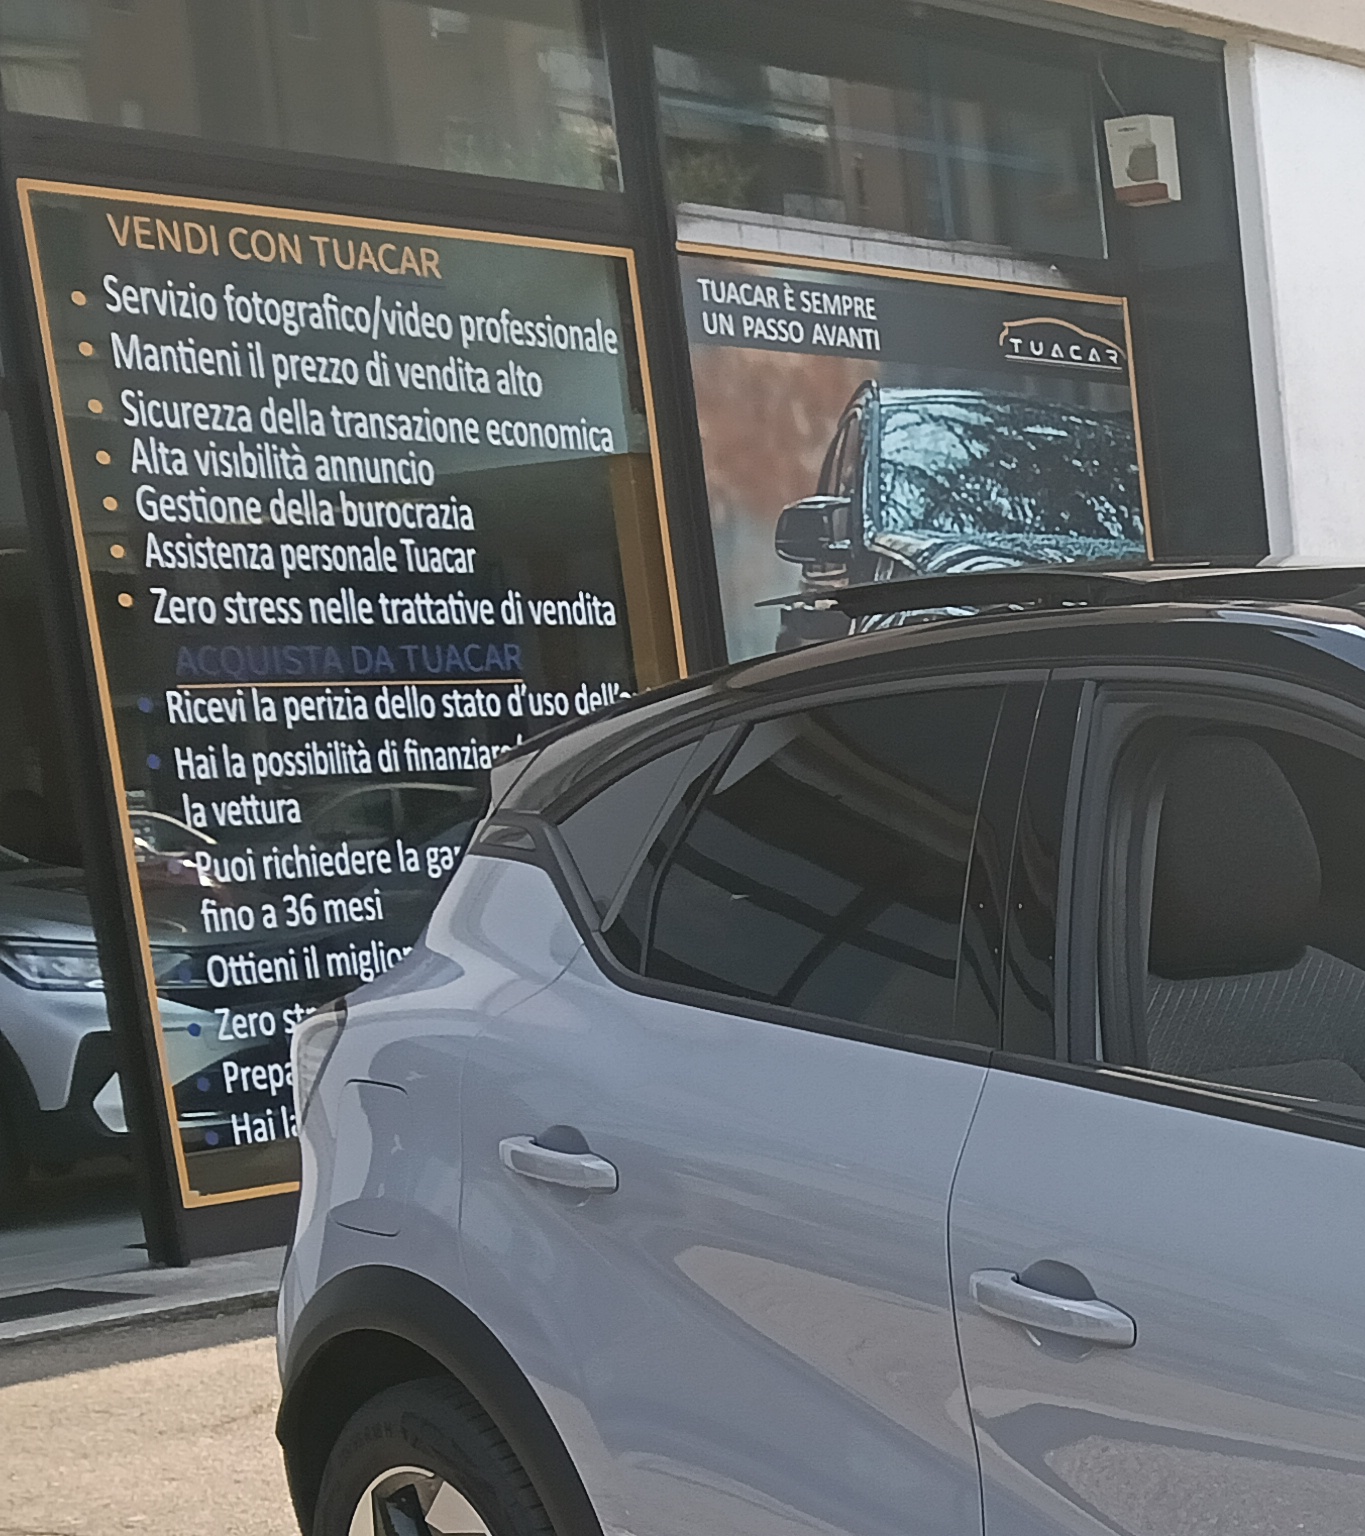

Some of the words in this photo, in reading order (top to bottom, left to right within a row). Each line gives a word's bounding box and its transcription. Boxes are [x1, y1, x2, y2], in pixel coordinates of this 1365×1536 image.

[107, 214, 219, 256] VENDI
[229, 228, 302, 264] CON
[310, 236, 441, 278] TUACAR
[104, 275, 217, 320] Servizio
[224, 284, 452, 340] fotografico/video
[460, 309, 617, 354] professionale
[697, 279, 780, 308] TUACAR
[784, 283, 796, 311] È
[800, 291, 877, 320] SEMPRE
[703, 312, 734, 336] UN
[743, 316, 804, 343] PASSO
[812, 323, 880, 350] AVANTI
[1009, 337, 1119, 364] TUACAR
[111, 332, 242, 376] Mantieni
[247, 342, 265, 378] il
[272, 354, 358, 388] prezzo
[366, 350, 390, 386] di
[395, 356, 490, 393] vendita
[496, 360, 542, 397] alto
[121, 390, 252, 432] Sicurezza
[261, 397, 325, 436] della
[331, 405, 480, 444] transazione
[486, 418, 615, 453] economica
[132, 437, 188, 475] Alta
[194, 441, 308, 480] visibilità
[315, 451, 434, 485] annuncio
[136, 485, 262, 524] Gestione
[270, 488, 335, 526] della
[340, 491, 474, 530] burocrazia
[146, 532, 274, 570] Assistenza
[280, 536, 397, 578] personale
[400, 539, 476, 573] Tuacar
[150, 588, 216, 624] Zero
[224, 592, 302, 624] stress
[309, 588, 374, 624] nelle
[378, 591, 494, 624] trattative
[501, 590, 523, 624] di
[528, 591, 616, 625] vendita
[177, 647, 344, 678] ACQUISTA
[352, 647, 394, 675] DA
[405, 644, 522, 673] TUACAR
[166, 689, 247, 723] Ricevi
[252, 688, 274, 721] la
[283, 690, 368, 729] perizia
[375, 685, 435, 719] dello
[442, 689, 501, 717] stato
[508, 684, 569, 716] d'uso
[575, 683, 637, 715] dell'
[175, 746, 218, 779] Hai
[222, 744, 246, 778] la
[252, 740, 372, 785] possibilità
[378, 739, 400, 772] di
[182, 793, 206, 828] la
[212, 794, 301, 826] vettura
[195, 849, 256, 886] Puoi
[263, 842, 391, 879] richiedere
[397, 839, 420, 872] la
[427, 845, 460, 878] ga
[201, 899, 254, 932] fino
[262, 904, 277, 928] a
[283, 893, 316, 926] 36
[324, 888, 383, 923] mesi
[207, 952, 298, 987] Ottieni
[303, 945, 320, 979] il
[215, 1008, 275, 1040] Zero
[231, 1109, 275, 1145] Hai
